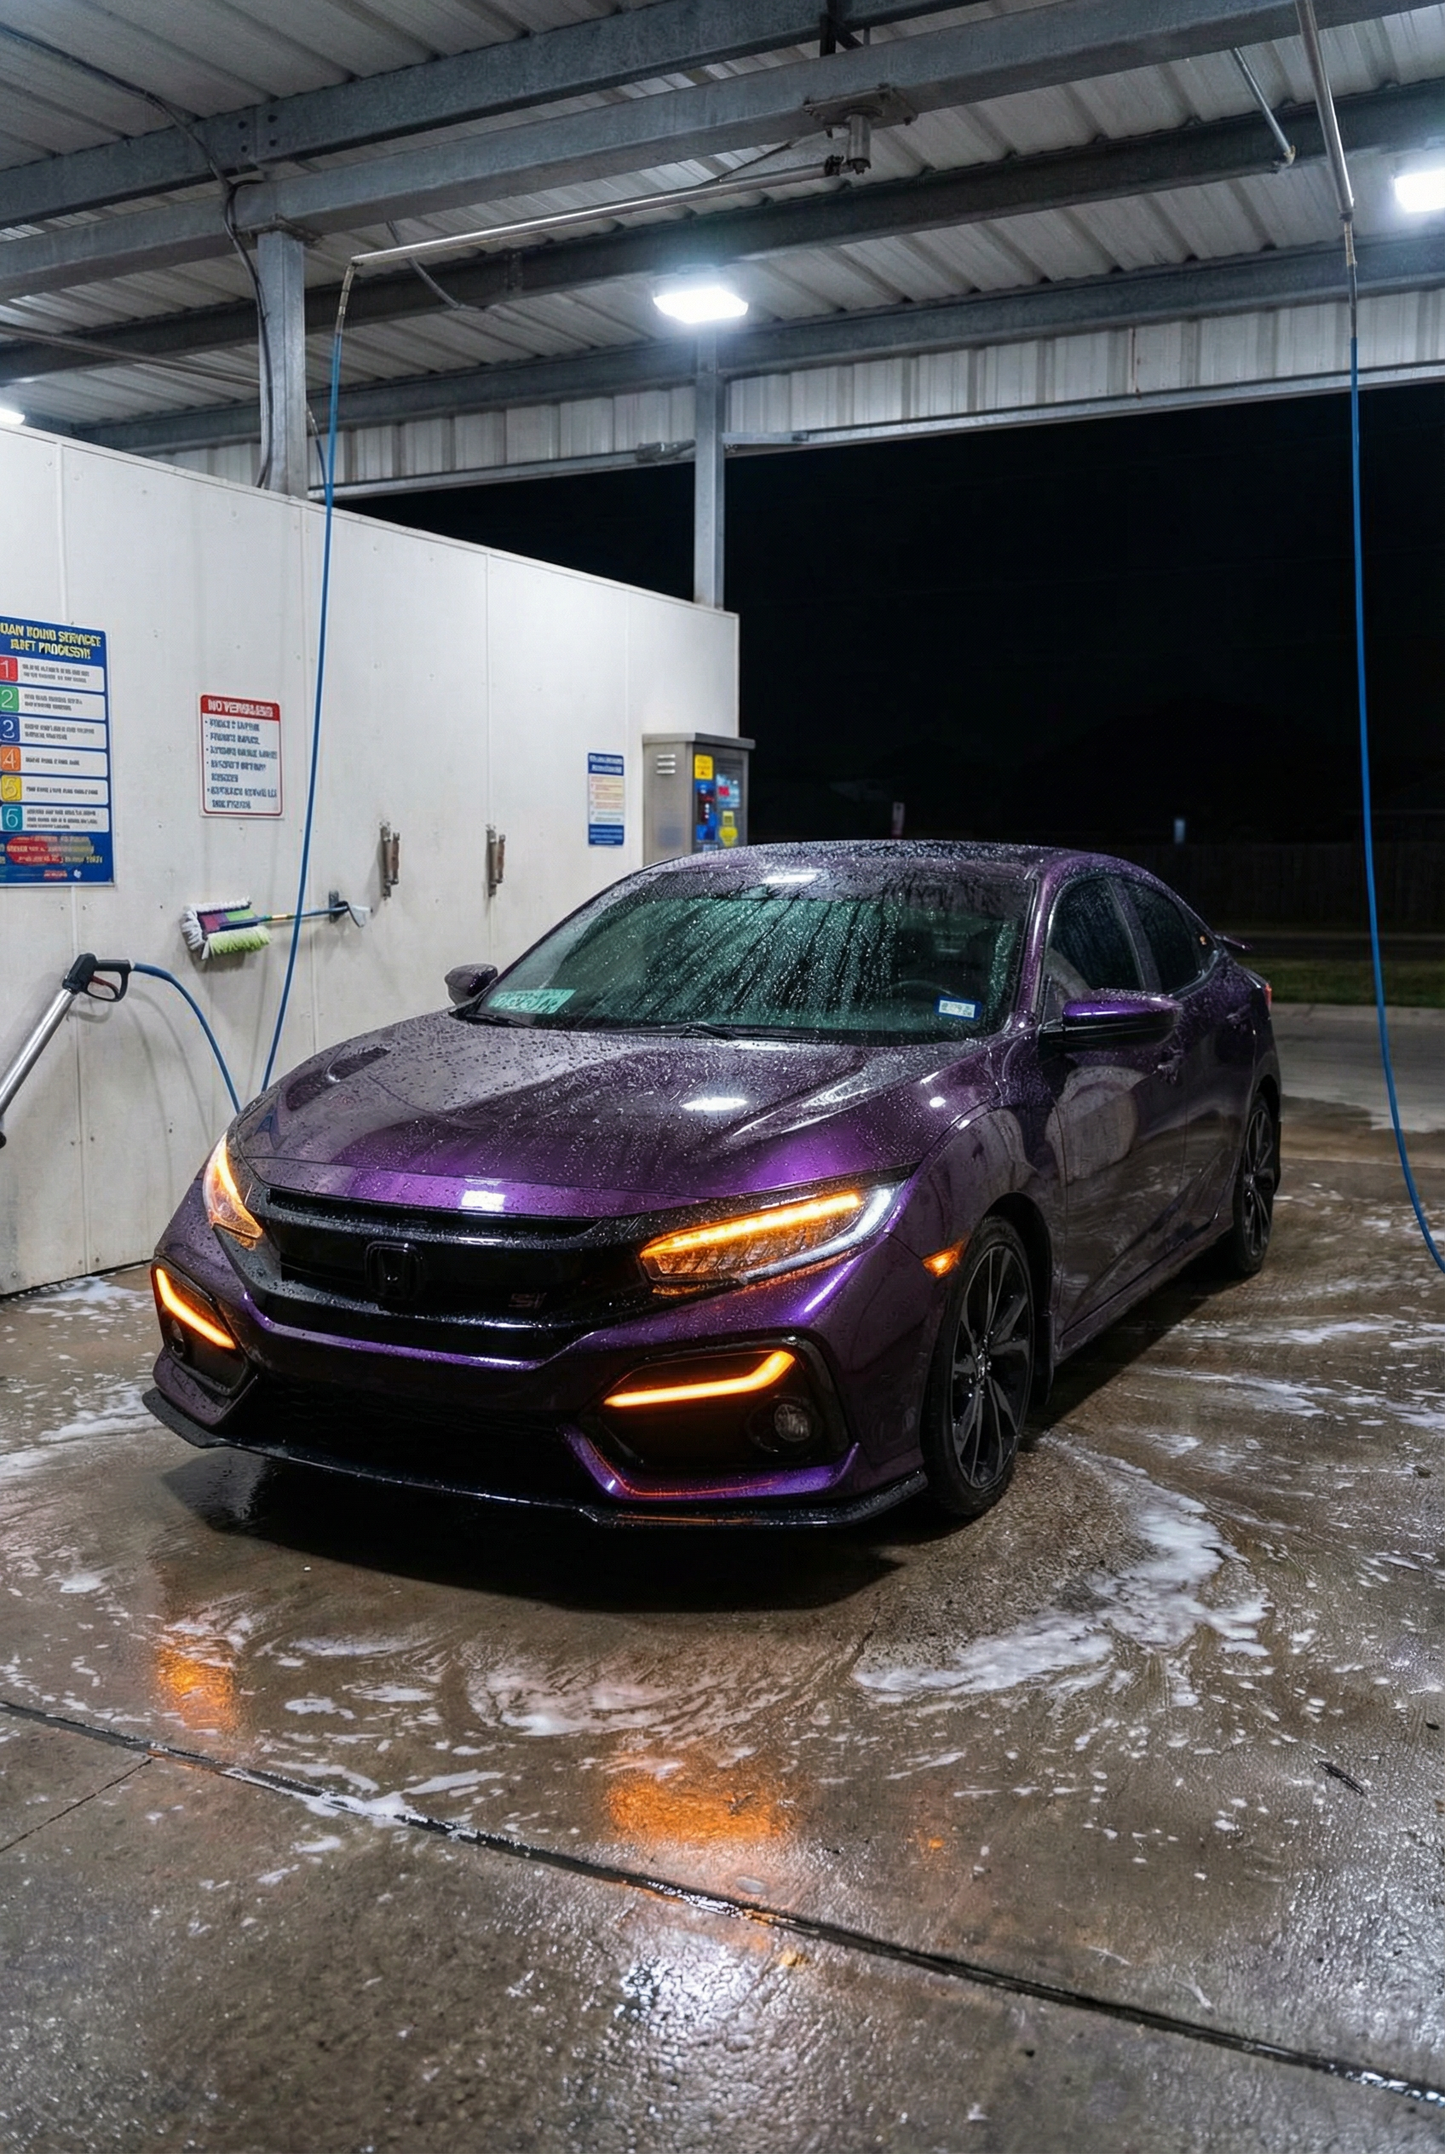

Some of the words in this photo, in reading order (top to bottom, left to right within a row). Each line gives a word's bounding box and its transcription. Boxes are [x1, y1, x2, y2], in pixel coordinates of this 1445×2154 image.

[1, 689, 14, 708] 2
[3, 749, 16, 769] 4
[5, 808, 19, 828] 6
